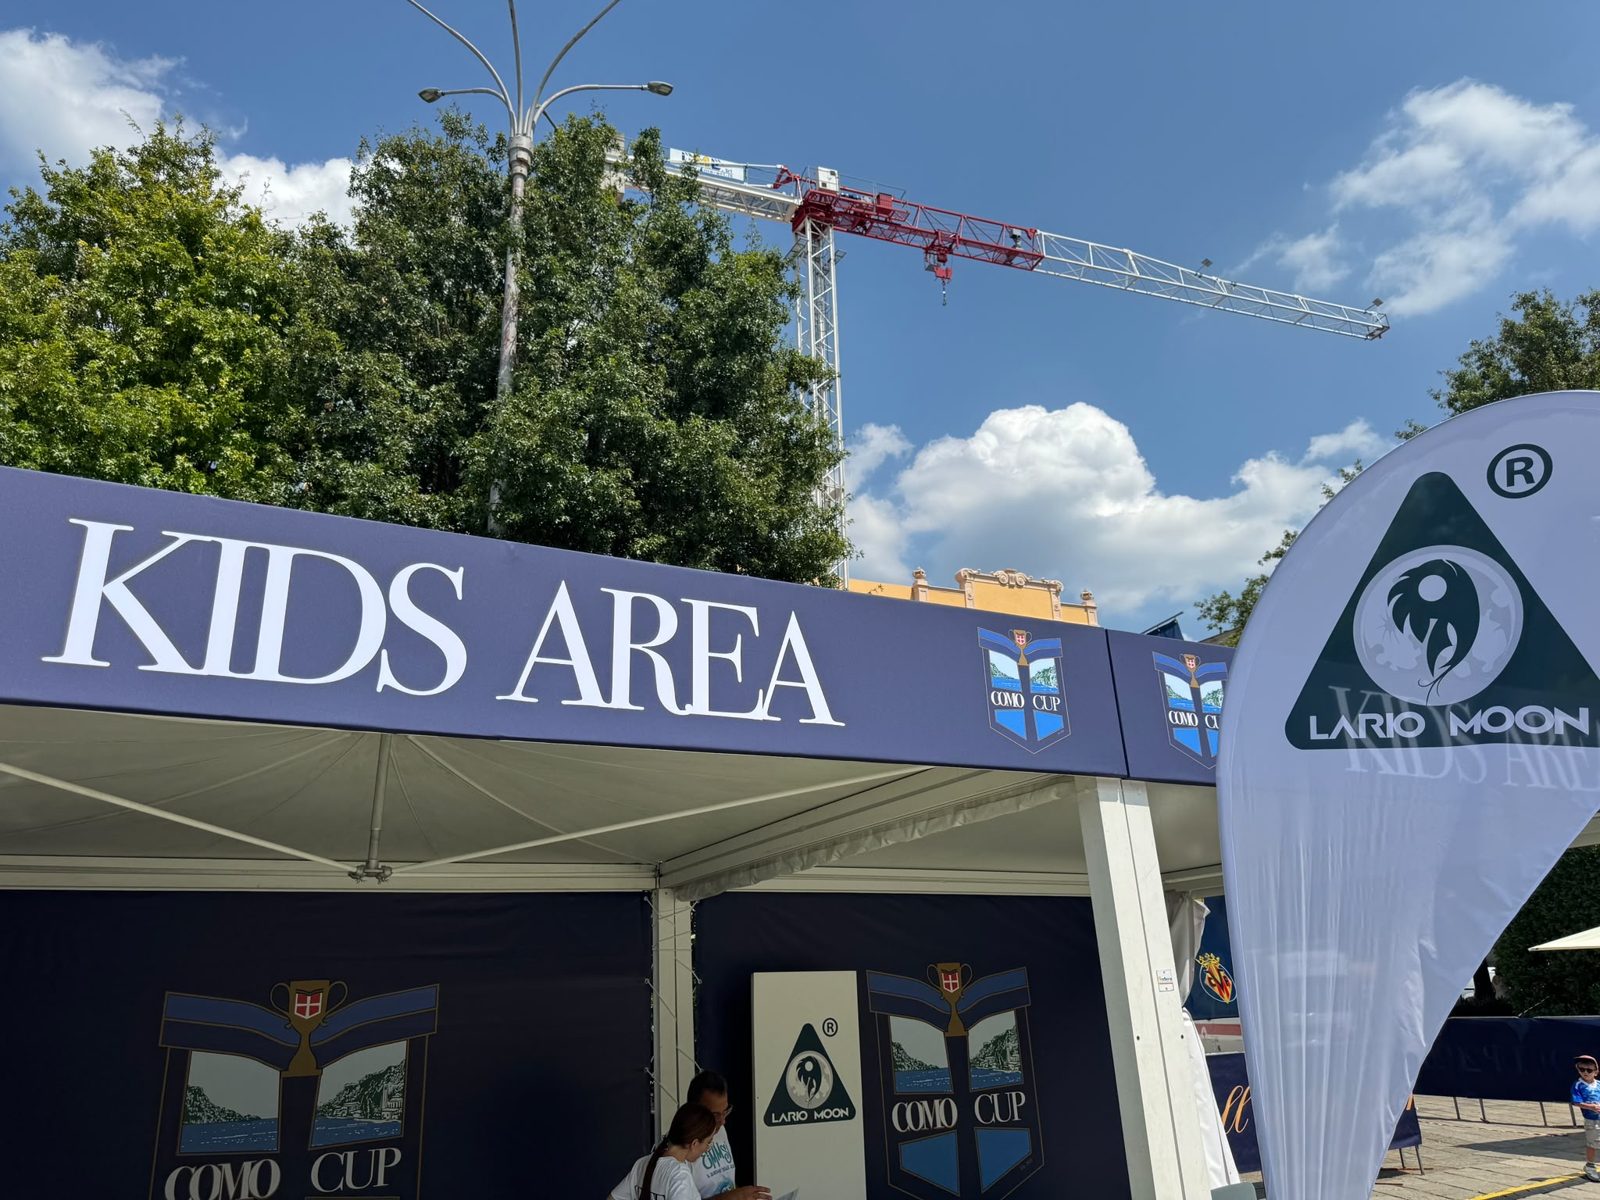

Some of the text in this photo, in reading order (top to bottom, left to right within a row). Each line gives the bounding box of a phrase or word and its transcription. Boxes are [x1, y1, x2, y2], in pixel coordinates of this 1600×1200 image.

[41, 518, 846, 727] KIDS AREA
[990, 690, 1061, 712] COMO CUP
[1168, 709, 1199, 727] COMO
[1309, 704, 1590, 741] LARIO MOON
[771, 1107, 849, 1123] LARIO MOON
[891, 1091, 1026, 1133] COMO CUP
[164, 1147, 402, 1200] COMO CUP
